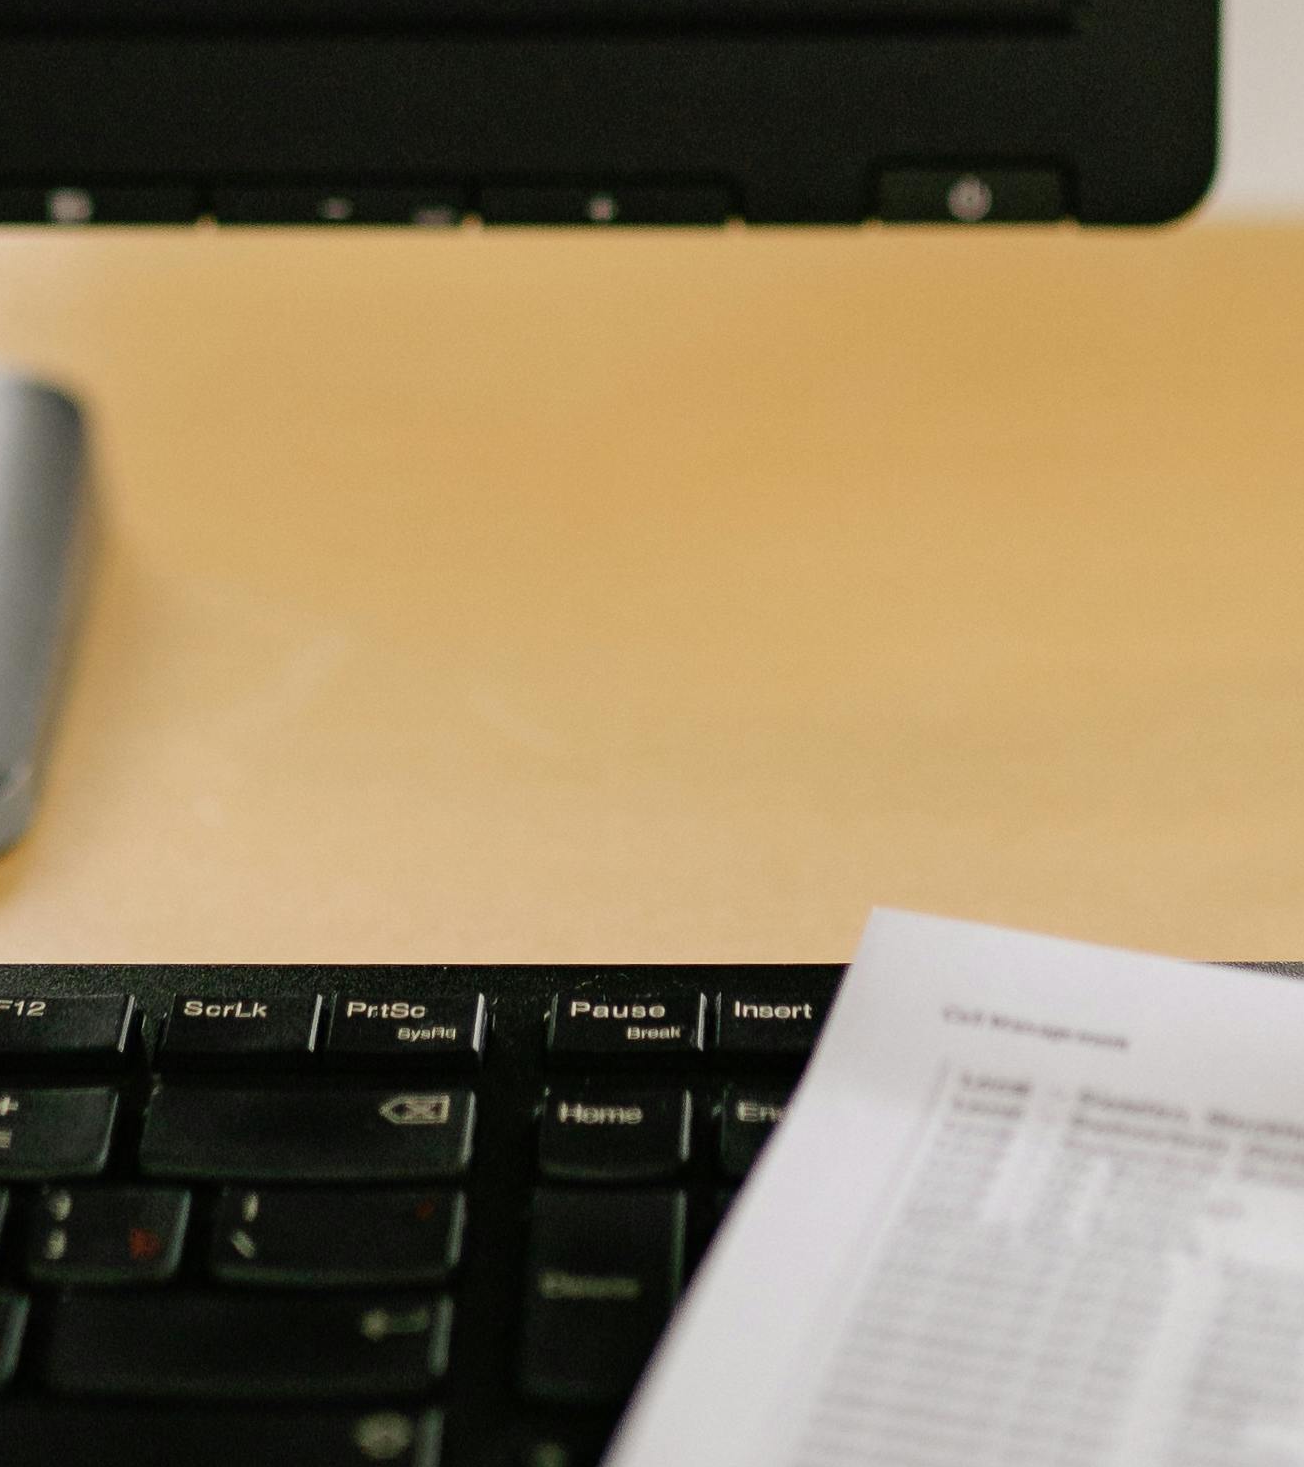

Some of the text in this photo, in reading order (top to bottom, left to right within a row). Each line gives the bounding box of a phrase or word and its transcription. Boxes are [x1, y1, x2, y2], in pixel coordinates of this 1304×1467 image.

[183, 1000, 268, 1018] ScrLk
[346, 1001, 426, 1019] PrtSc
[570, 1000, 666, 1019] Pause
[734, 1000, 813, 1019] Insert
[626, 1025, 681, 1040] Break
[558, 1101, 643, 1125] Home
